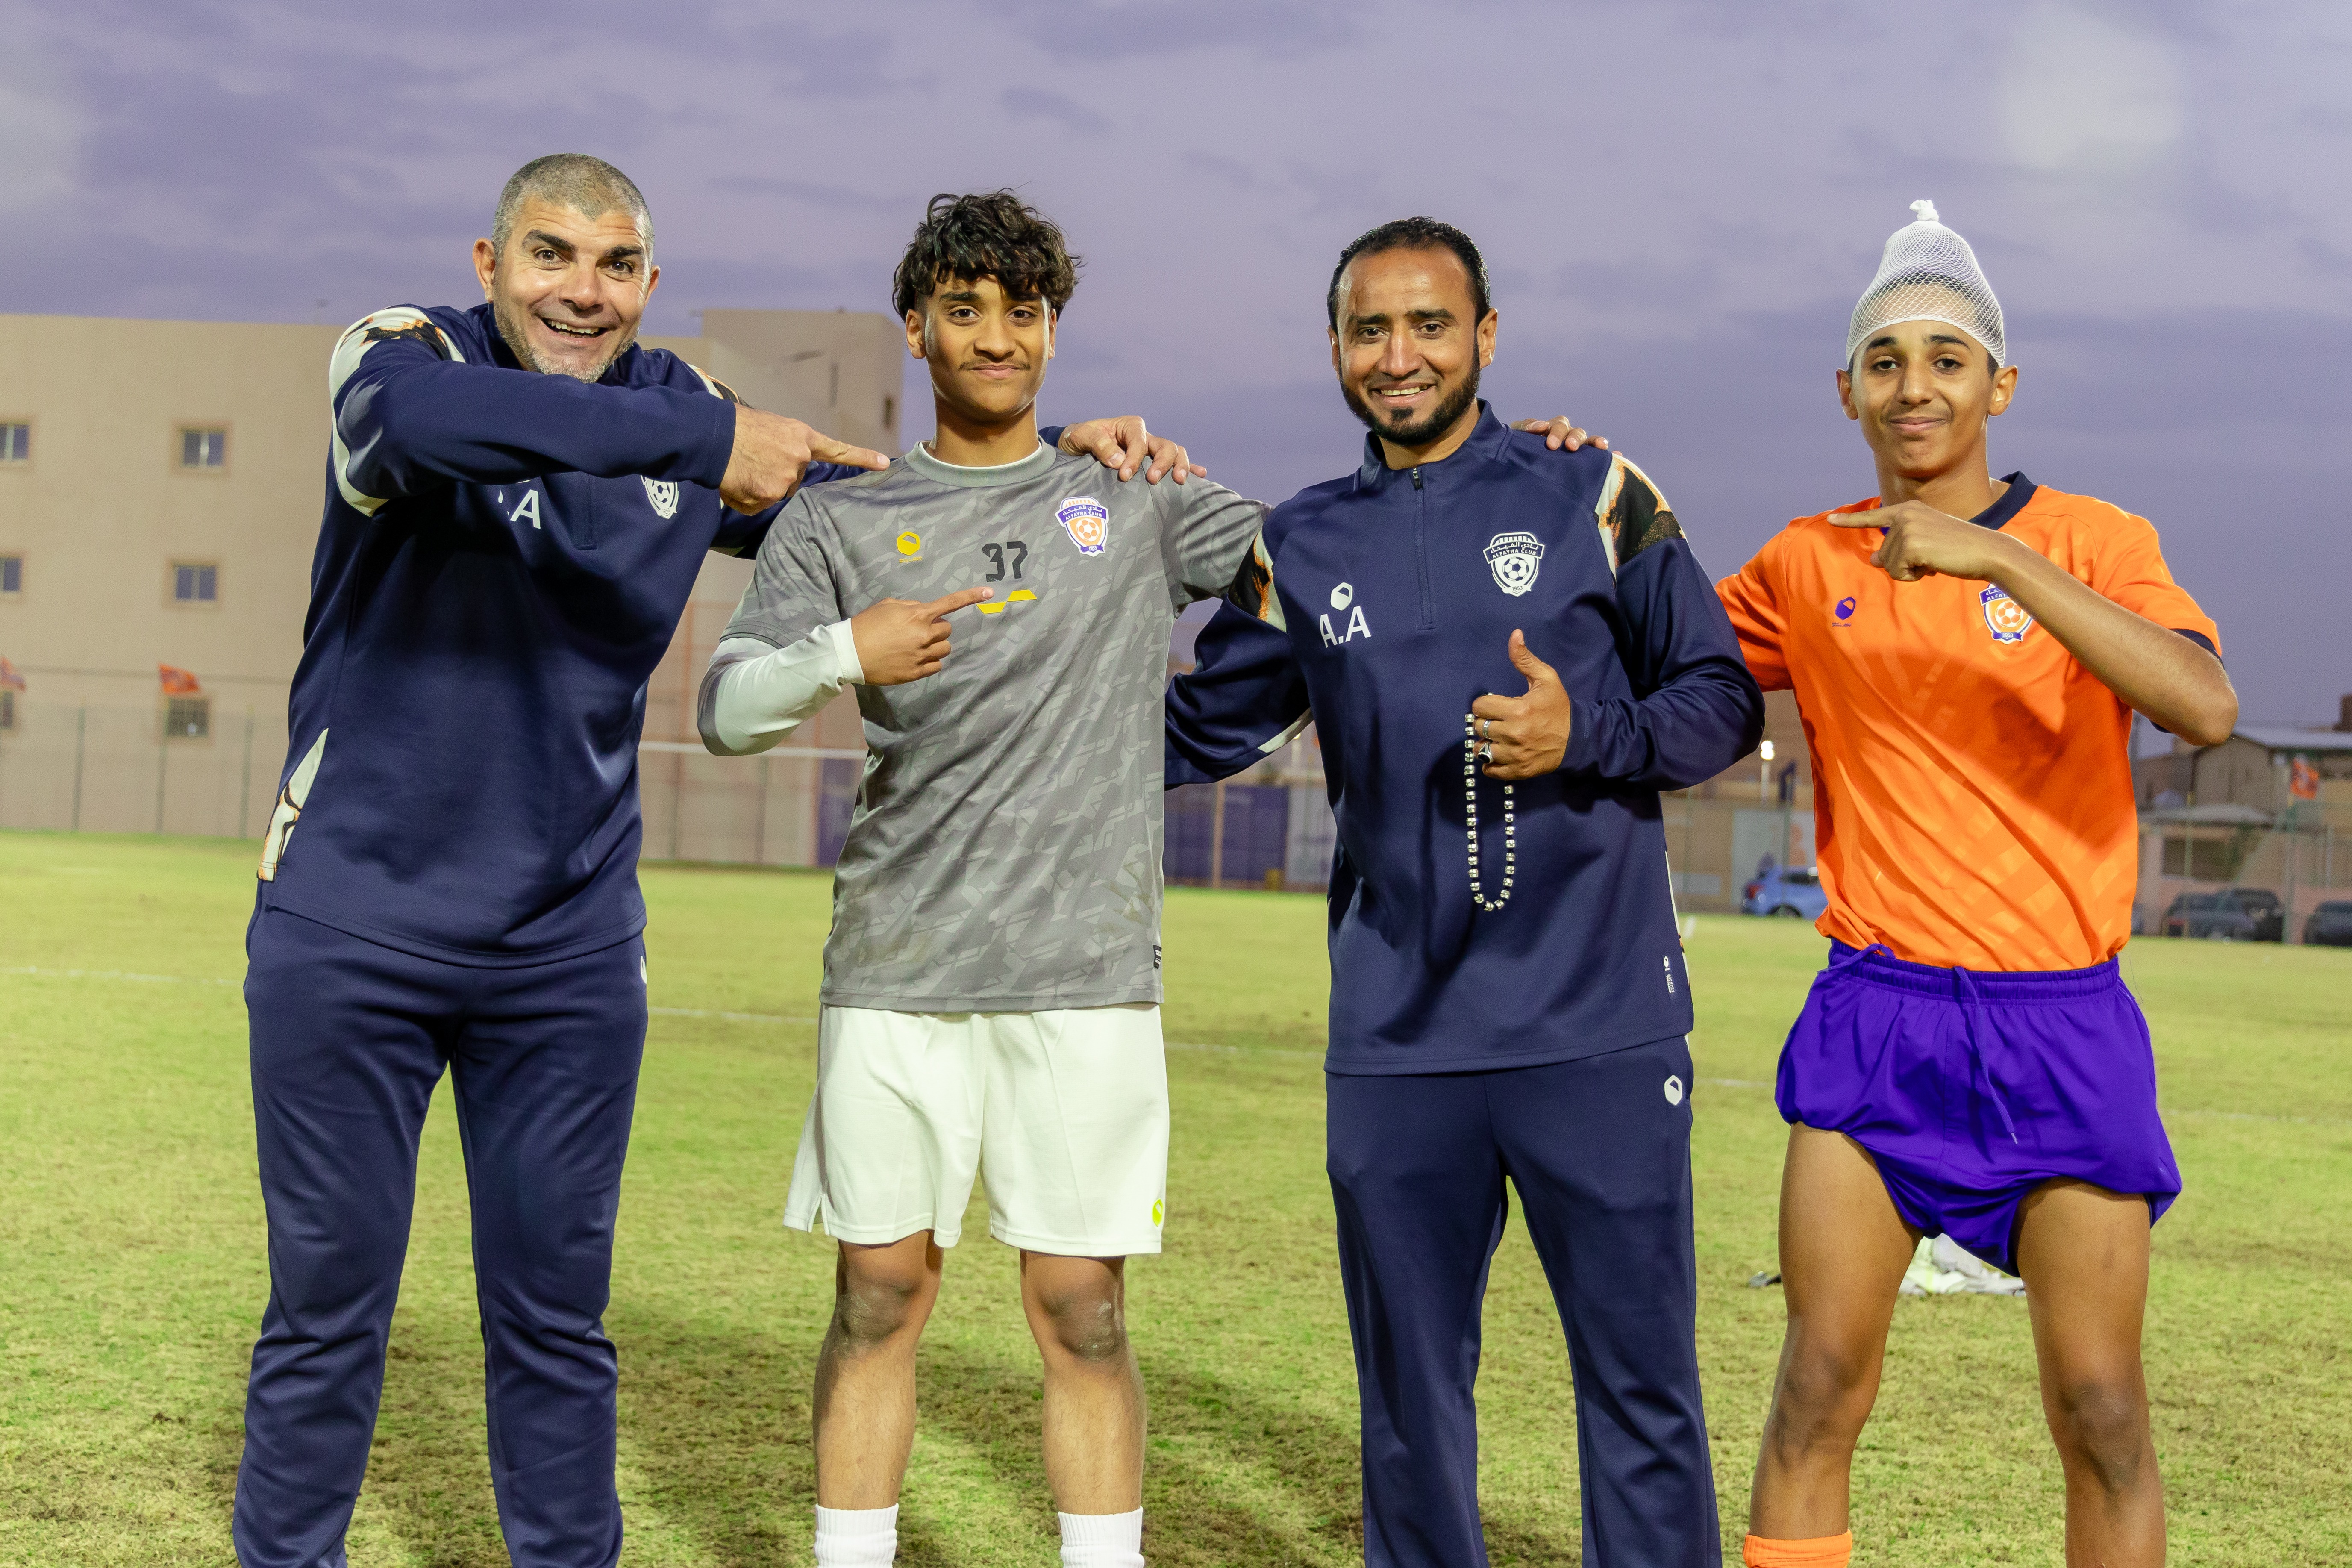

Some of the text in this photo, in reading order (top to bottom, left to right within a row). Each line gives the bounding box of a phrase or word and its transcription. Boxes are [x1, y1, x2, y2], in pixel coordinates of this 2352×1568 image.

[1065, 511, 1087, 521] ALFAYHA
[1492, 548, 1519, 559] ALFAYHA
[982, 541, 1028, 582] 37
[1987, 593, 2007, 601] ALFAY
[1320, 606, 1371, 648] A.A
